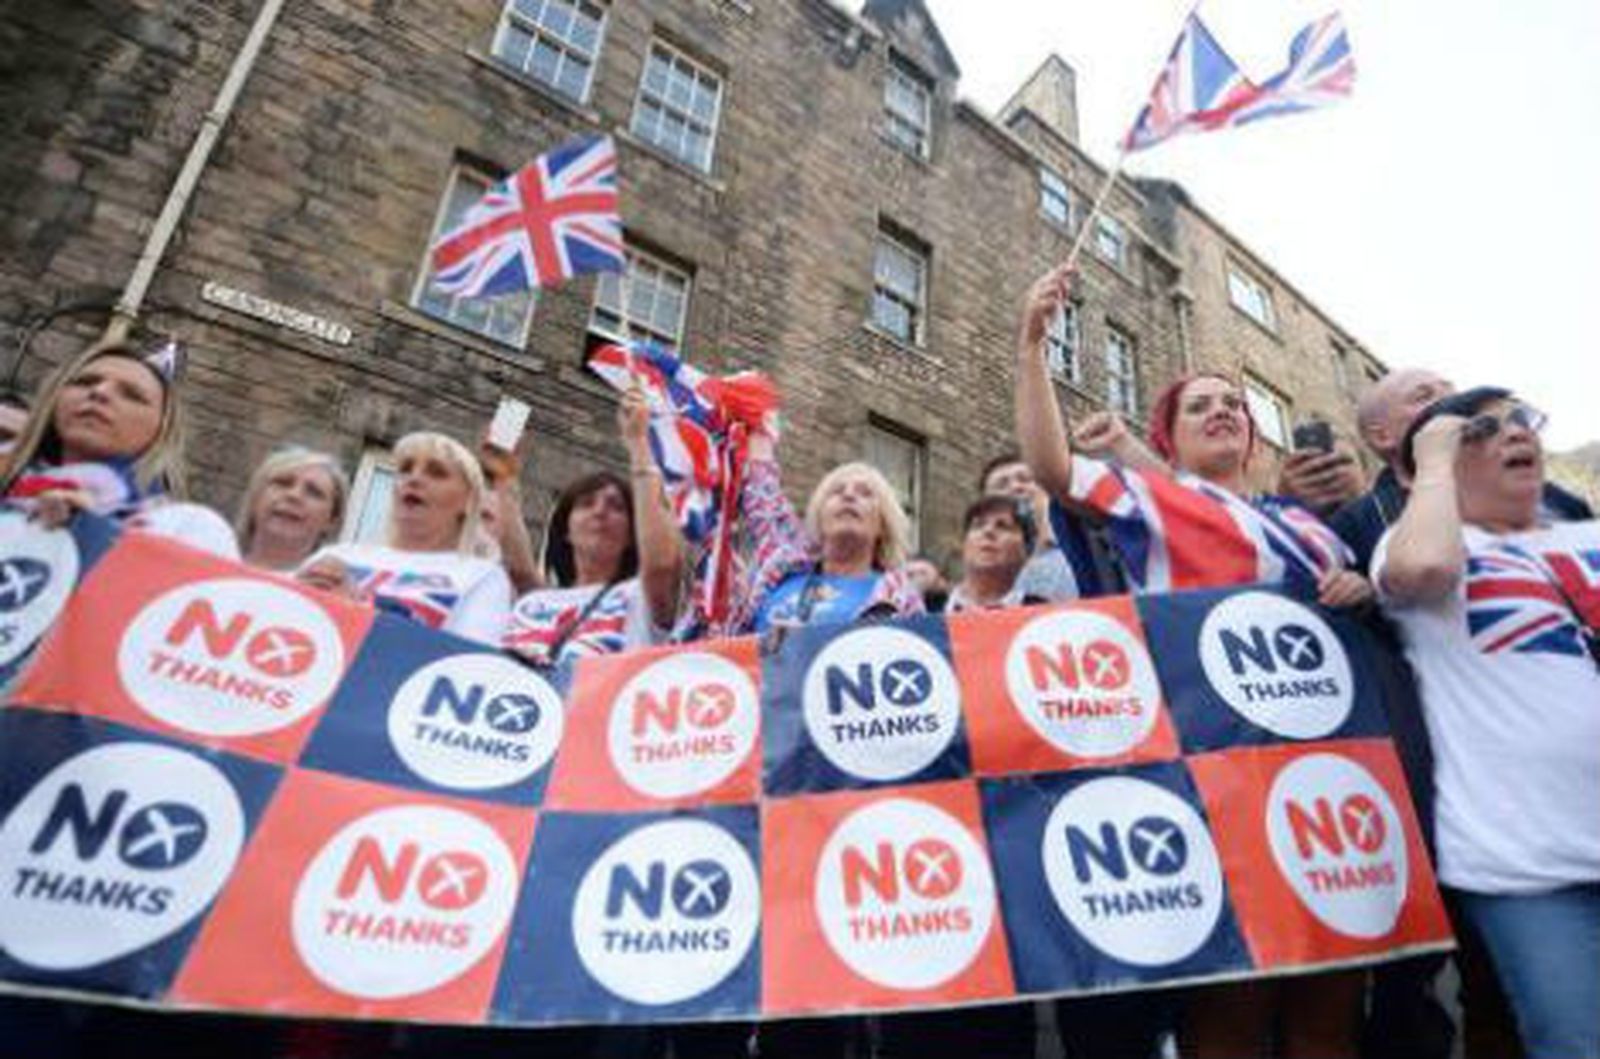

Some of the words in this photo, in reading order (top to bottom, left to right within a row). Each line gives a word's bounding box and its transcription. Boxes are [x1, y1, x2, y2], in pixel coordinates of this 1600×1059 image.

[165, 598, 317, 678] NO
[1217, 624, 1325, 675] NO
[147, 651, 294, 710] THANKS
[825, 660, 933, 714] NO
[1024, 640, 1130, 691] NO
[1238, 678, 1340, 702] THANKS
[421, 676, 541, 733] NO
[632, 683, 736, 738] NO
[832, 714, 941, 744] THANKS
[412, 722, 530, 763] THANKS
[632, 733, 736, 764] THANKS
[30, 782, 209, 871] NO
[1064, 816, 1187, 884] NO
[1285, 793, 1387, 861] NO
[10, 868, 174, 916] THANKS
[335, 836, 488, 910] NO
[605, 859, 732, 920] NO
[839, 839, 962, 907] NO
[848, 908, 972, 942] THANKS
[1081, 884, 1203, 920] THANKS
[322, 909, 471, 948] THANKS
[601, 929, 731, 954] THANKS
